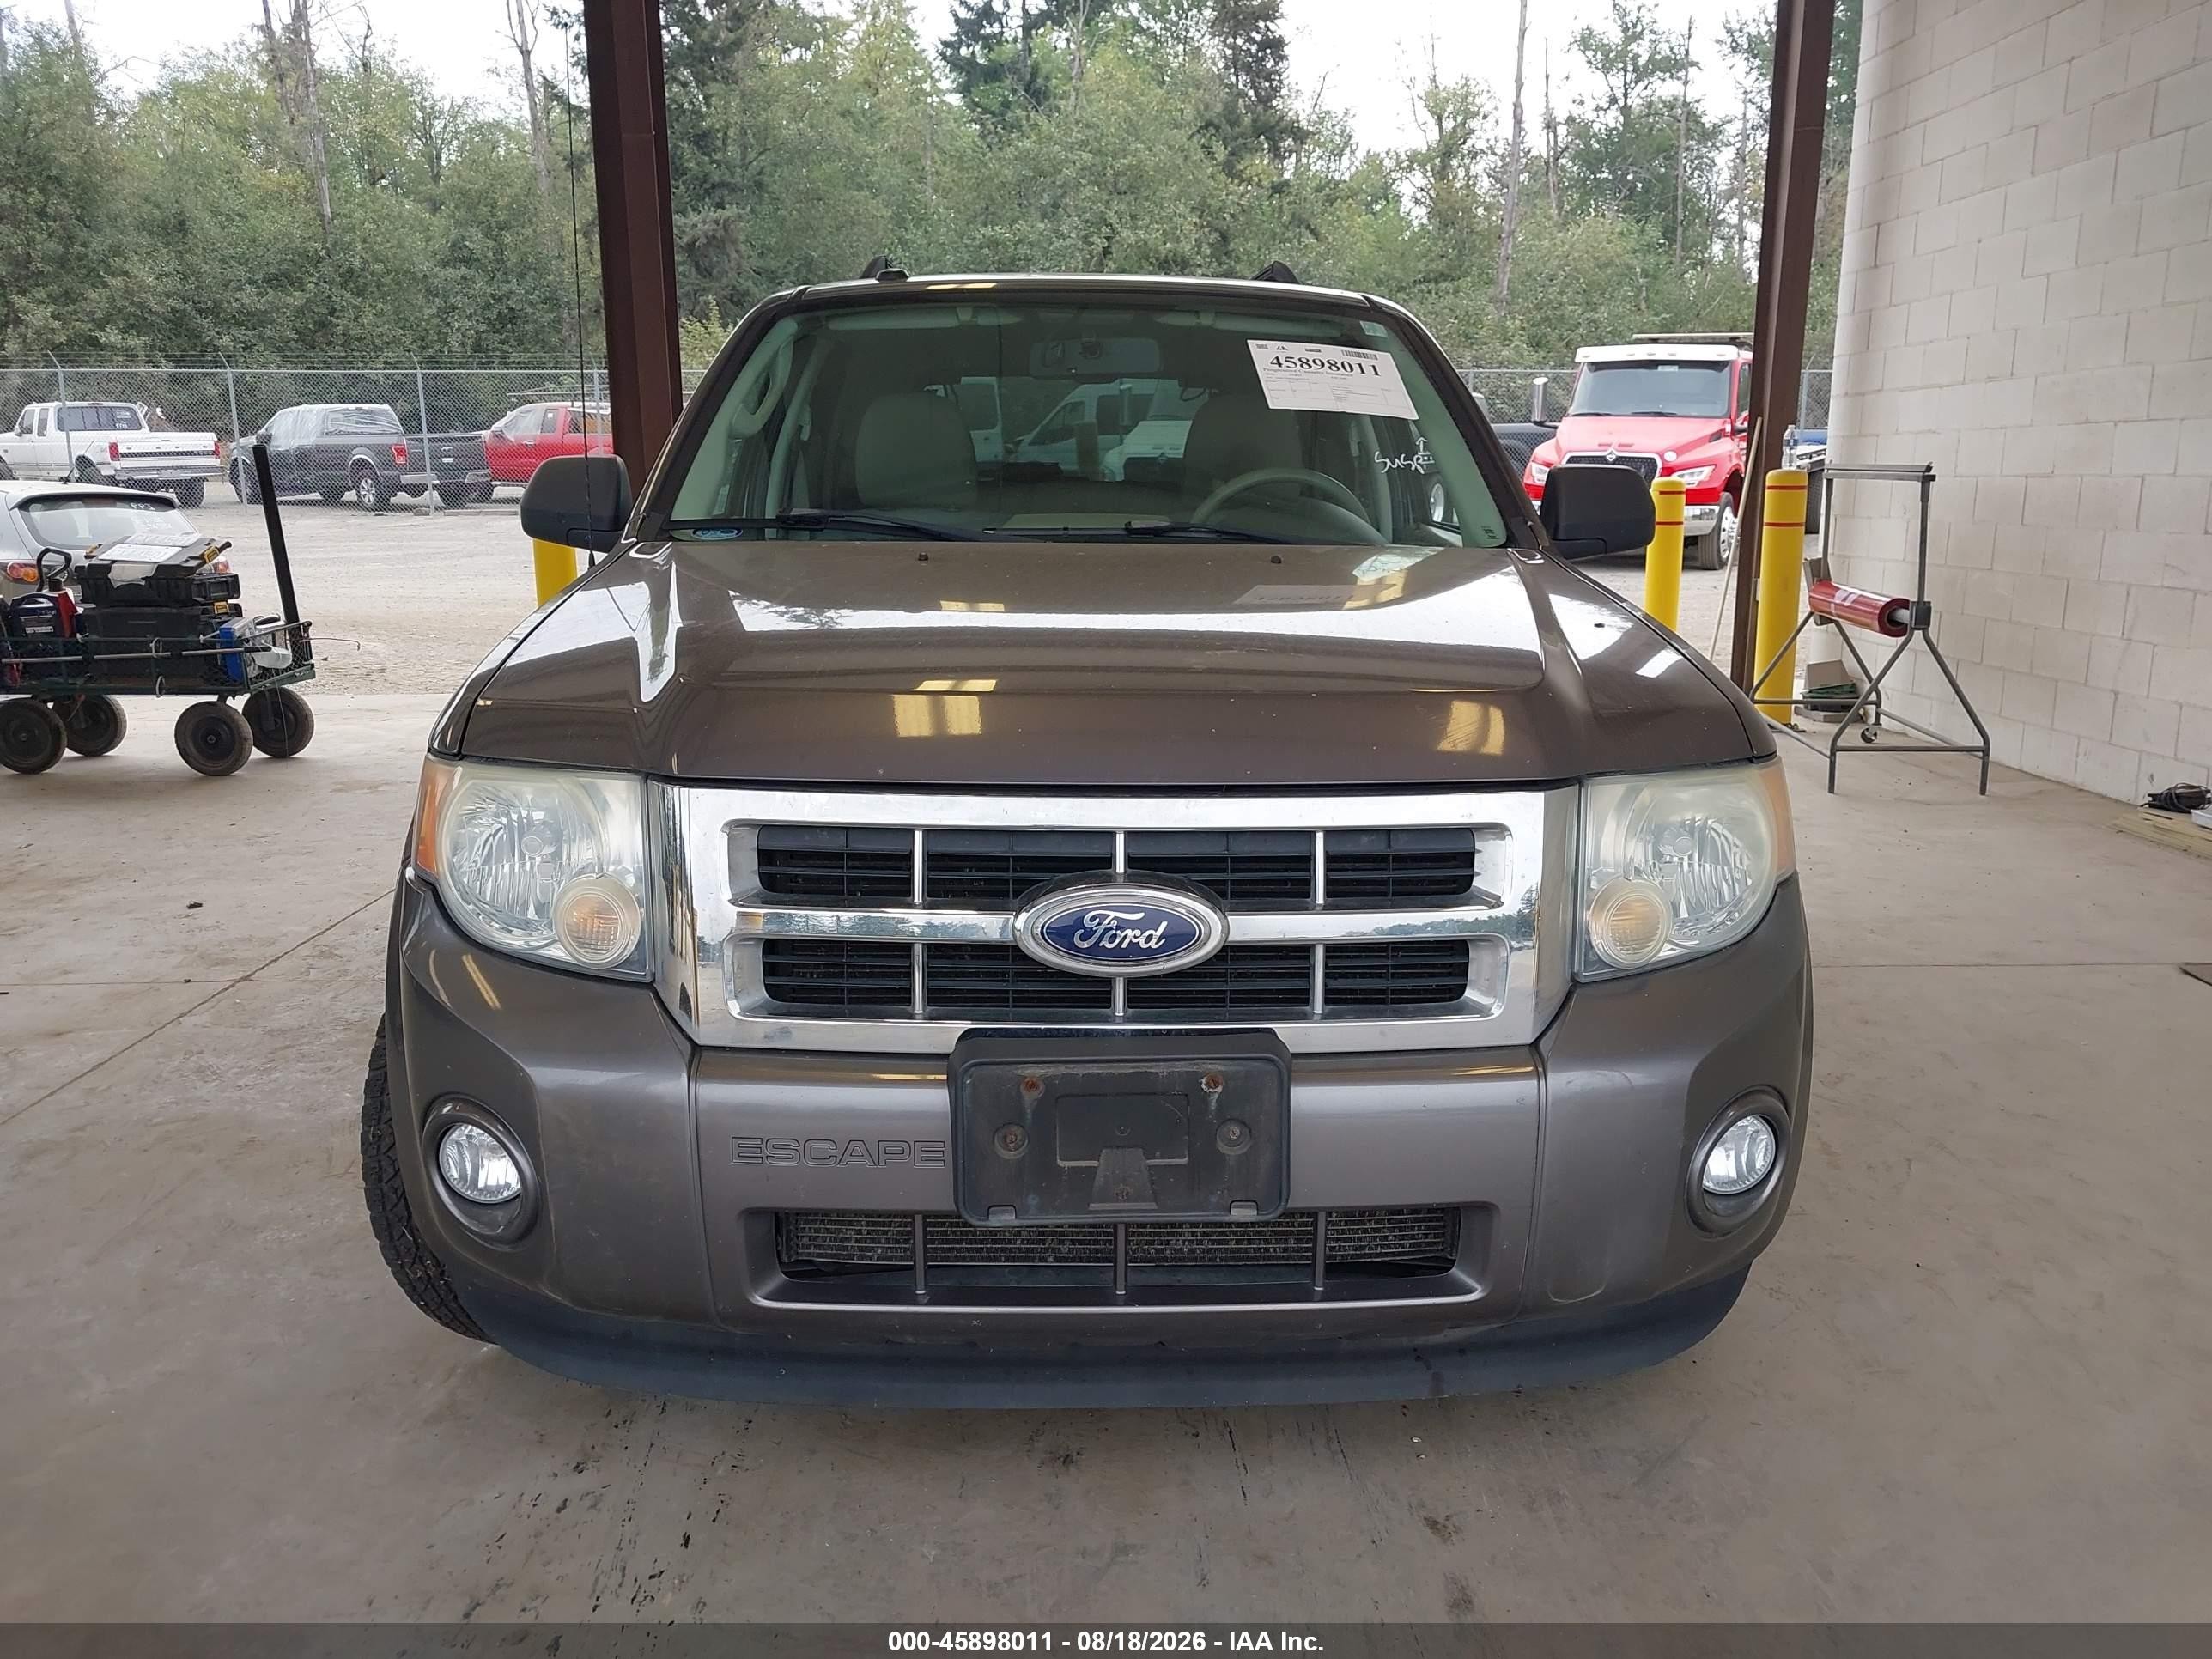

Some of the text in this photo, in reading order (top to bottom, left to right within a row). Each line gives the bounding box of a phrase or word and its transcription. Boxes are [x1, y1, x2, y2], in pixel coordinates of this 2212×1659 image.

[1270, 355, 1382, 377] 45898011
[1073, 909, 1168, 949] Ford
[731, 1136, 946, 1168] ESCAPE
